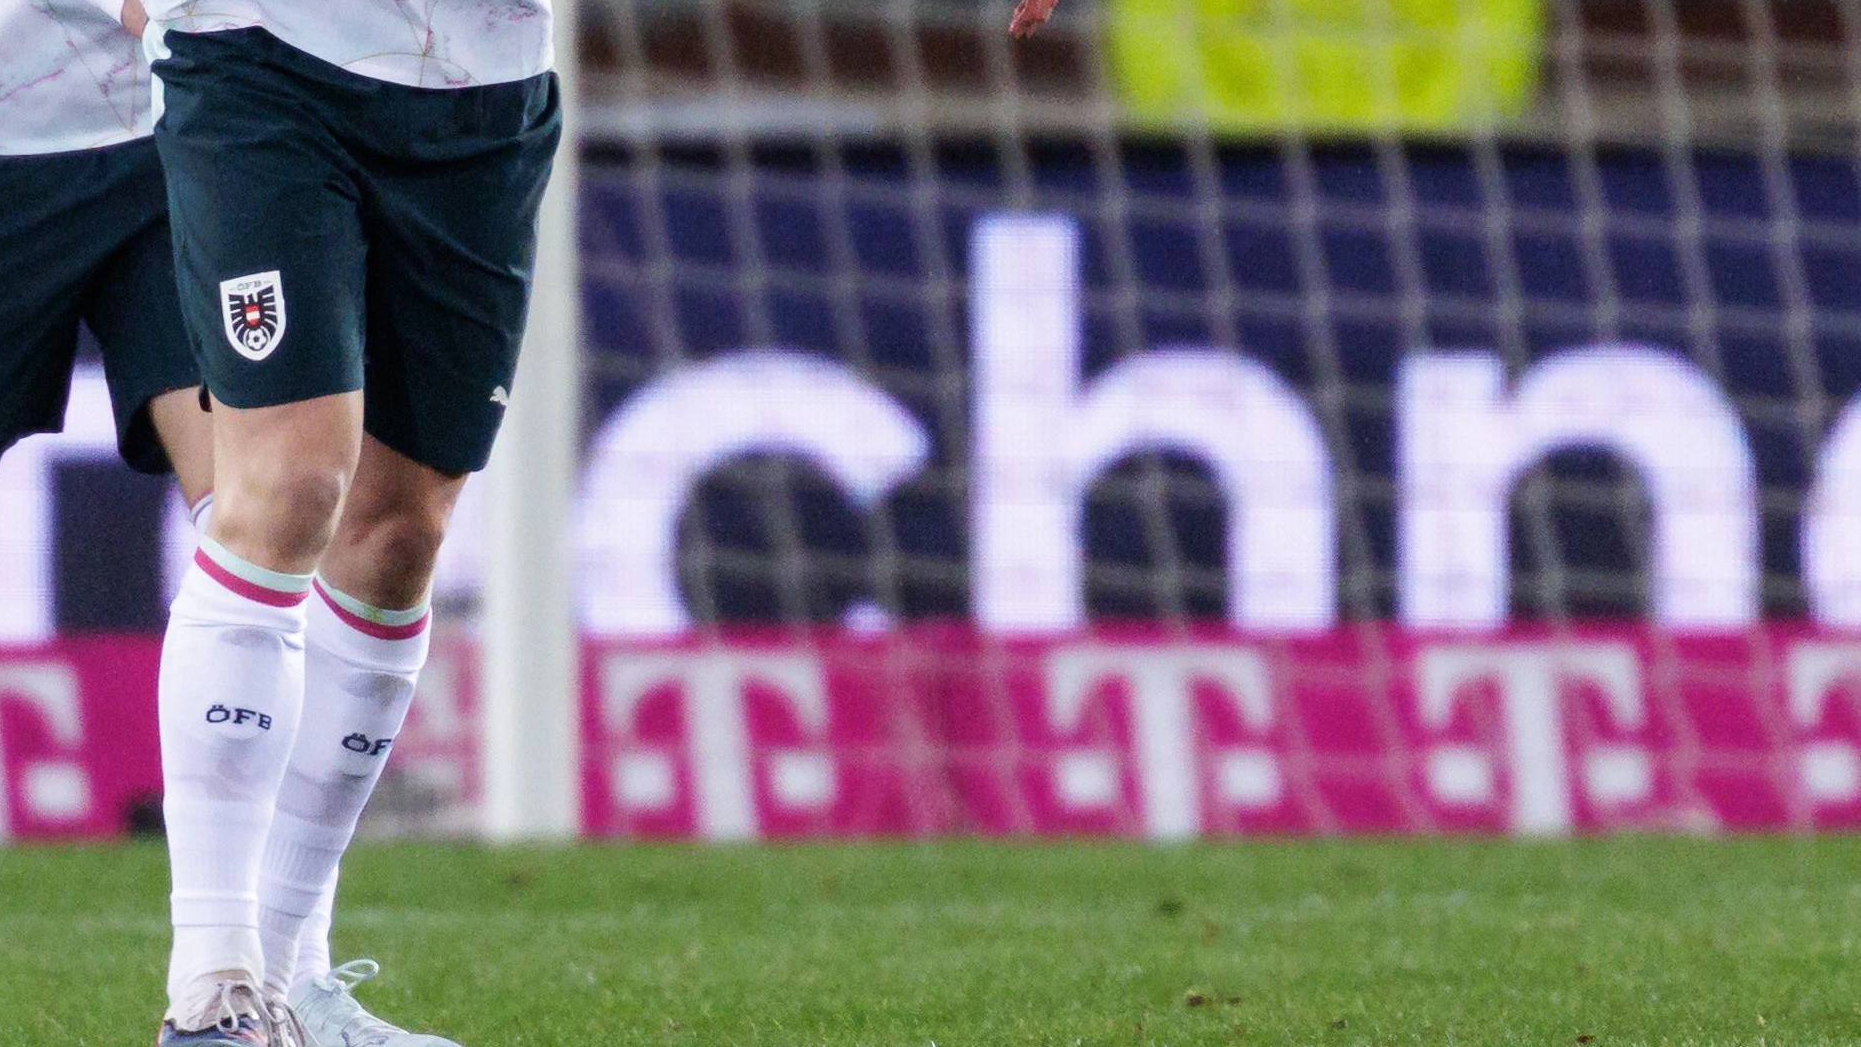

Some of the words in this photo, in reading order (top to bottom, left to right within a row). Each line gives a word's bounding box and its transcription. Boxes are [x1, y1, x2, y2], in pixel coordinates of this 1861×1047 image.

[206, 704, 272, 730] ÖFB
[1048, 646, 1282, 842] T
[1416, 642, 1652, 838] T
